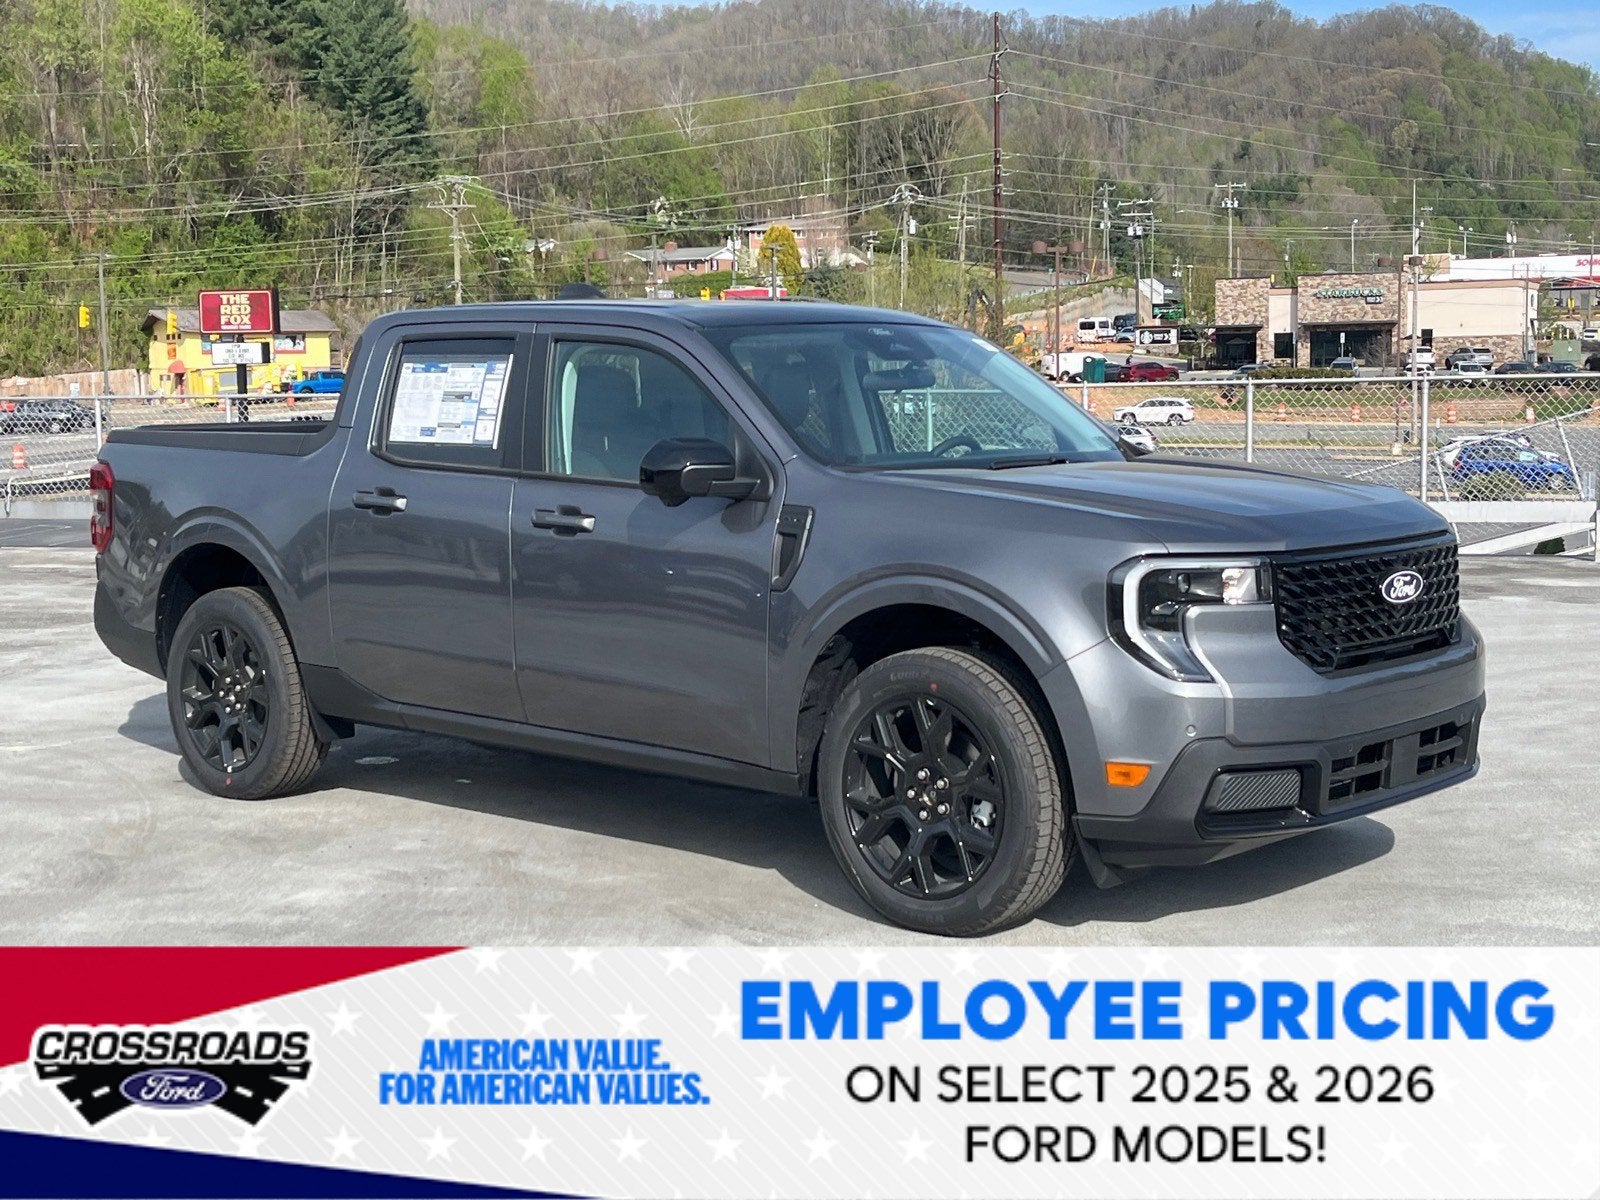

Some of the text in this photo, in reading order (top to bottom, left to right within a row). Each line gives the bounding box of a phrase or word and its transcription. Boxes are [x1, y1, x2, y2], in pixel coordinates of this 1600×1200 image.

[220, 294, 250, 304] THE
[220, 304, 251, 315] RED
[220, 315, 251, 325] FOX
[1390, 575, 1417, 598] Ford
